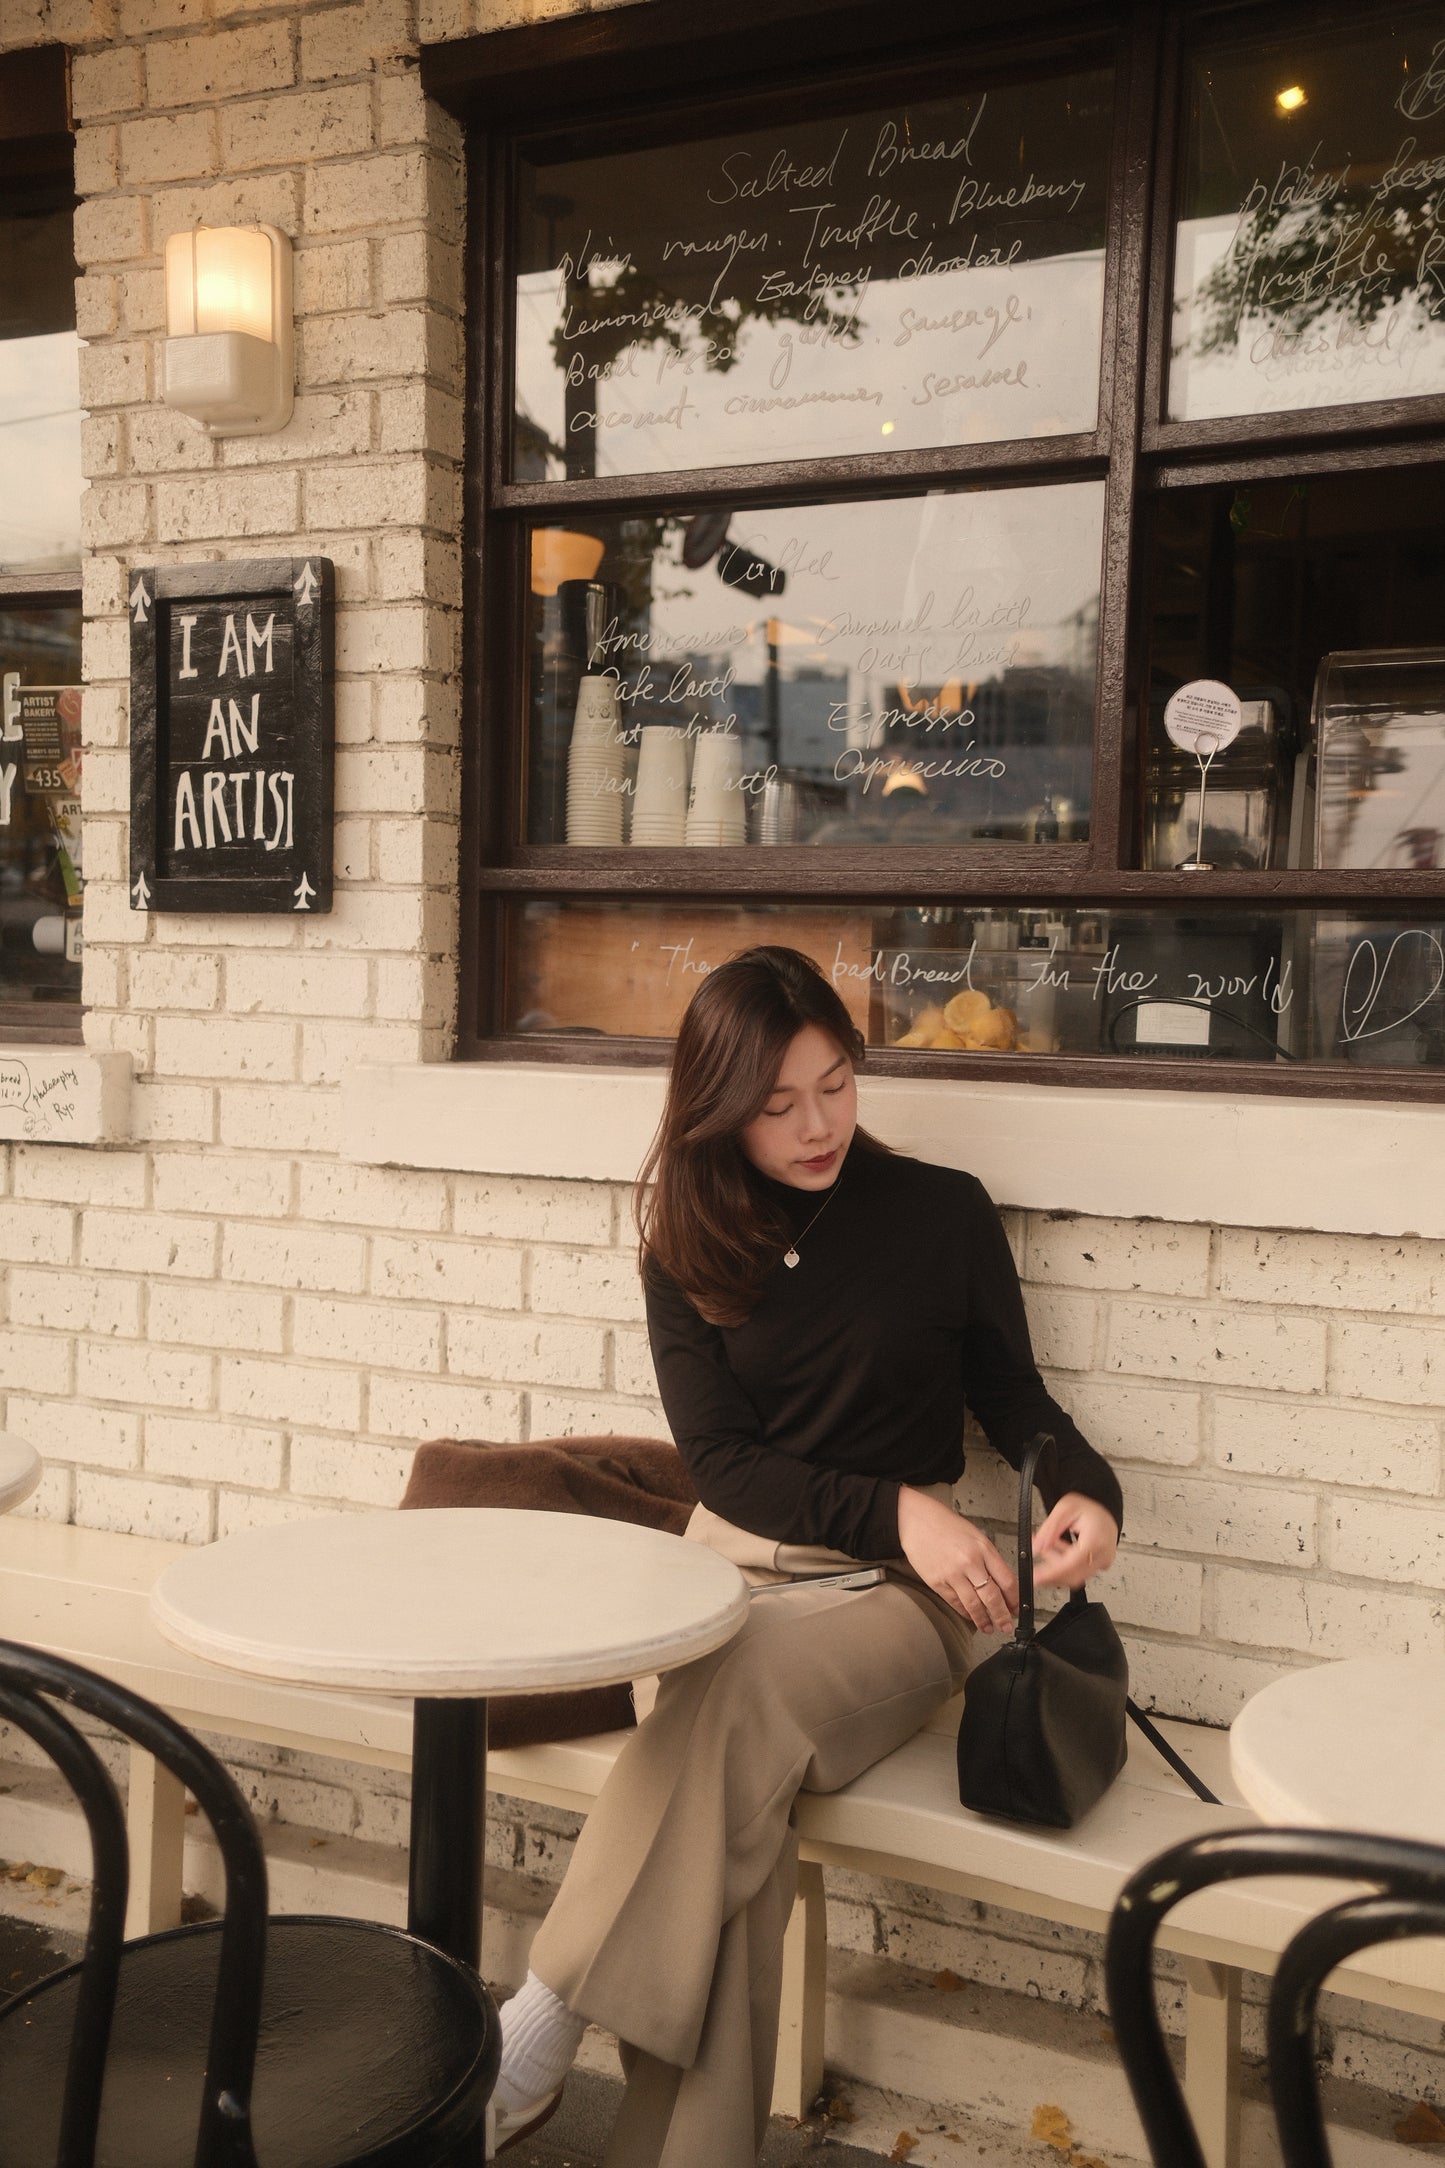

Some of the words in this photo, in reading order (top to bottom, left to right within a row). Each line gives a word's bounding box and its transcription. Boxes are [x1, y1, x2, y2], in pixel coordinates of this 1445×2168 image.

[707, 127, 848, 205] Salted
[867, 93, 988, 177] Bread
[179, 615, 199, 680] I
[218, 612, 276, 680] AM
[23, 697, 55, 707] ARTIST
[24, 708, 56, 717] BAKERY
[202, 693, 261, 761] AN
[827, 702, 976, 750] Espresso
[174, 770, 295, 852] ARTIST
[1092, 944, 1158, 1000] the
